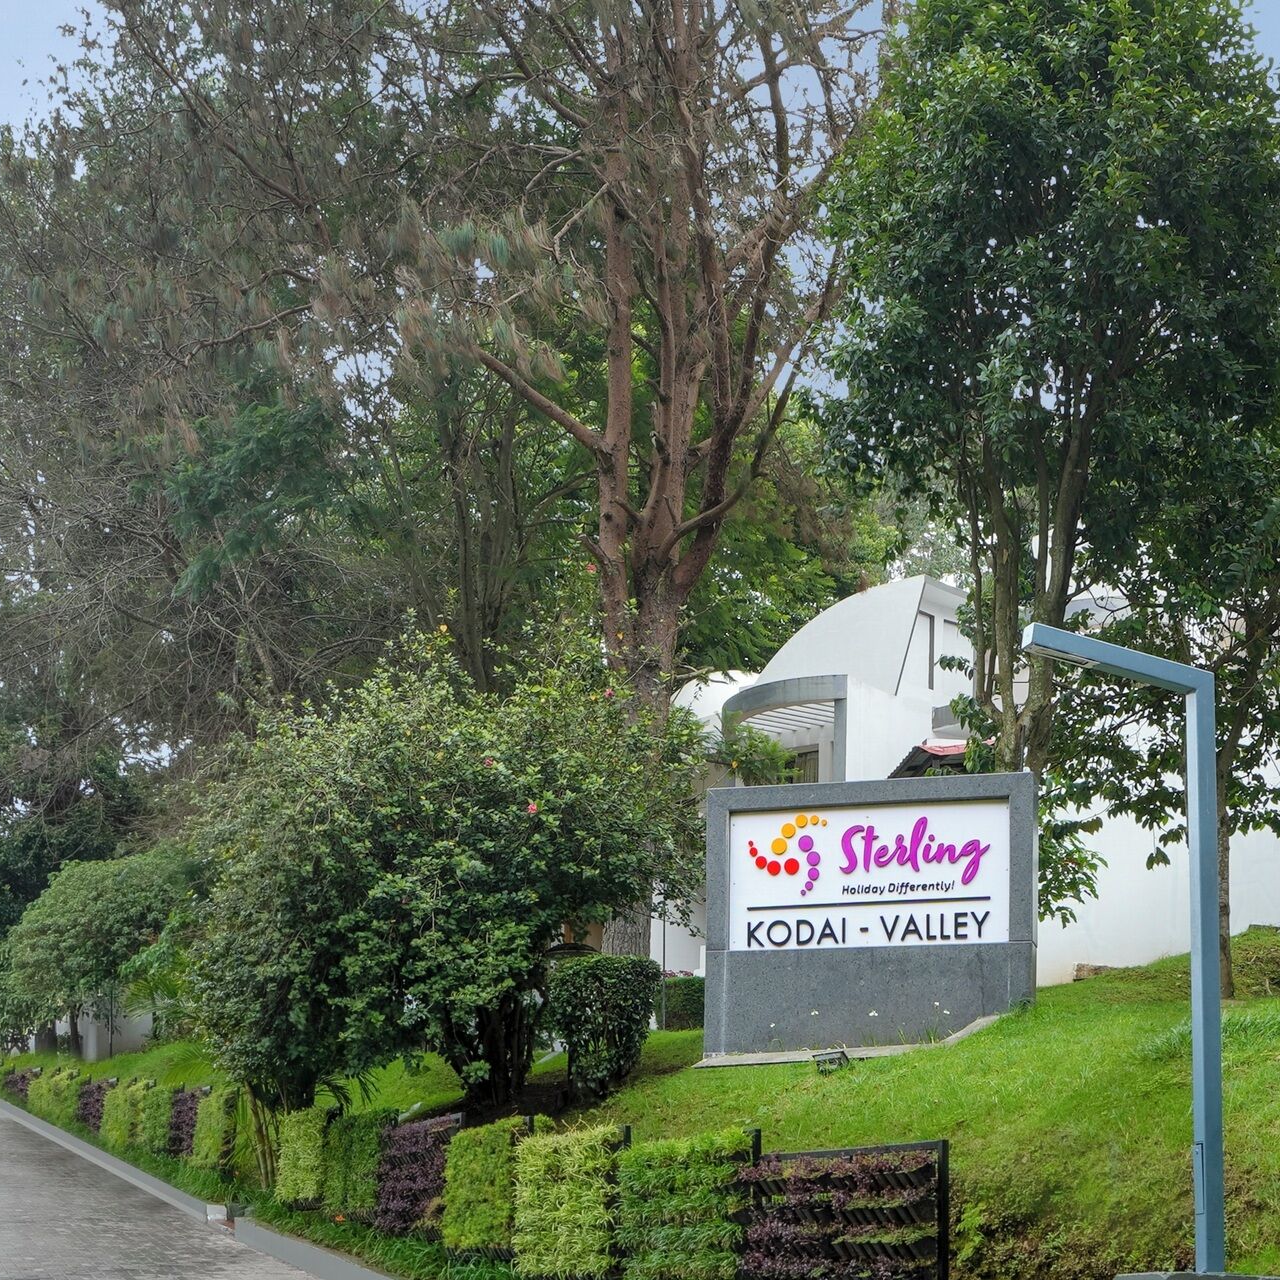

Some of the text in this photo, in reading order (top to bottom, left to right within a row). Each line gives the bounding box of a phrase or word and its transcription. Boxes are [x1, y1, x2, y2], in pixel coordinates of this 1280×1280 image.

[839, 816, 991, 886] Sterling
[841, 880, 956, 896] Holiday Differently!
[747, 917, 847, 948] KODAI
[879, 910, 991, 943] VALLEY
